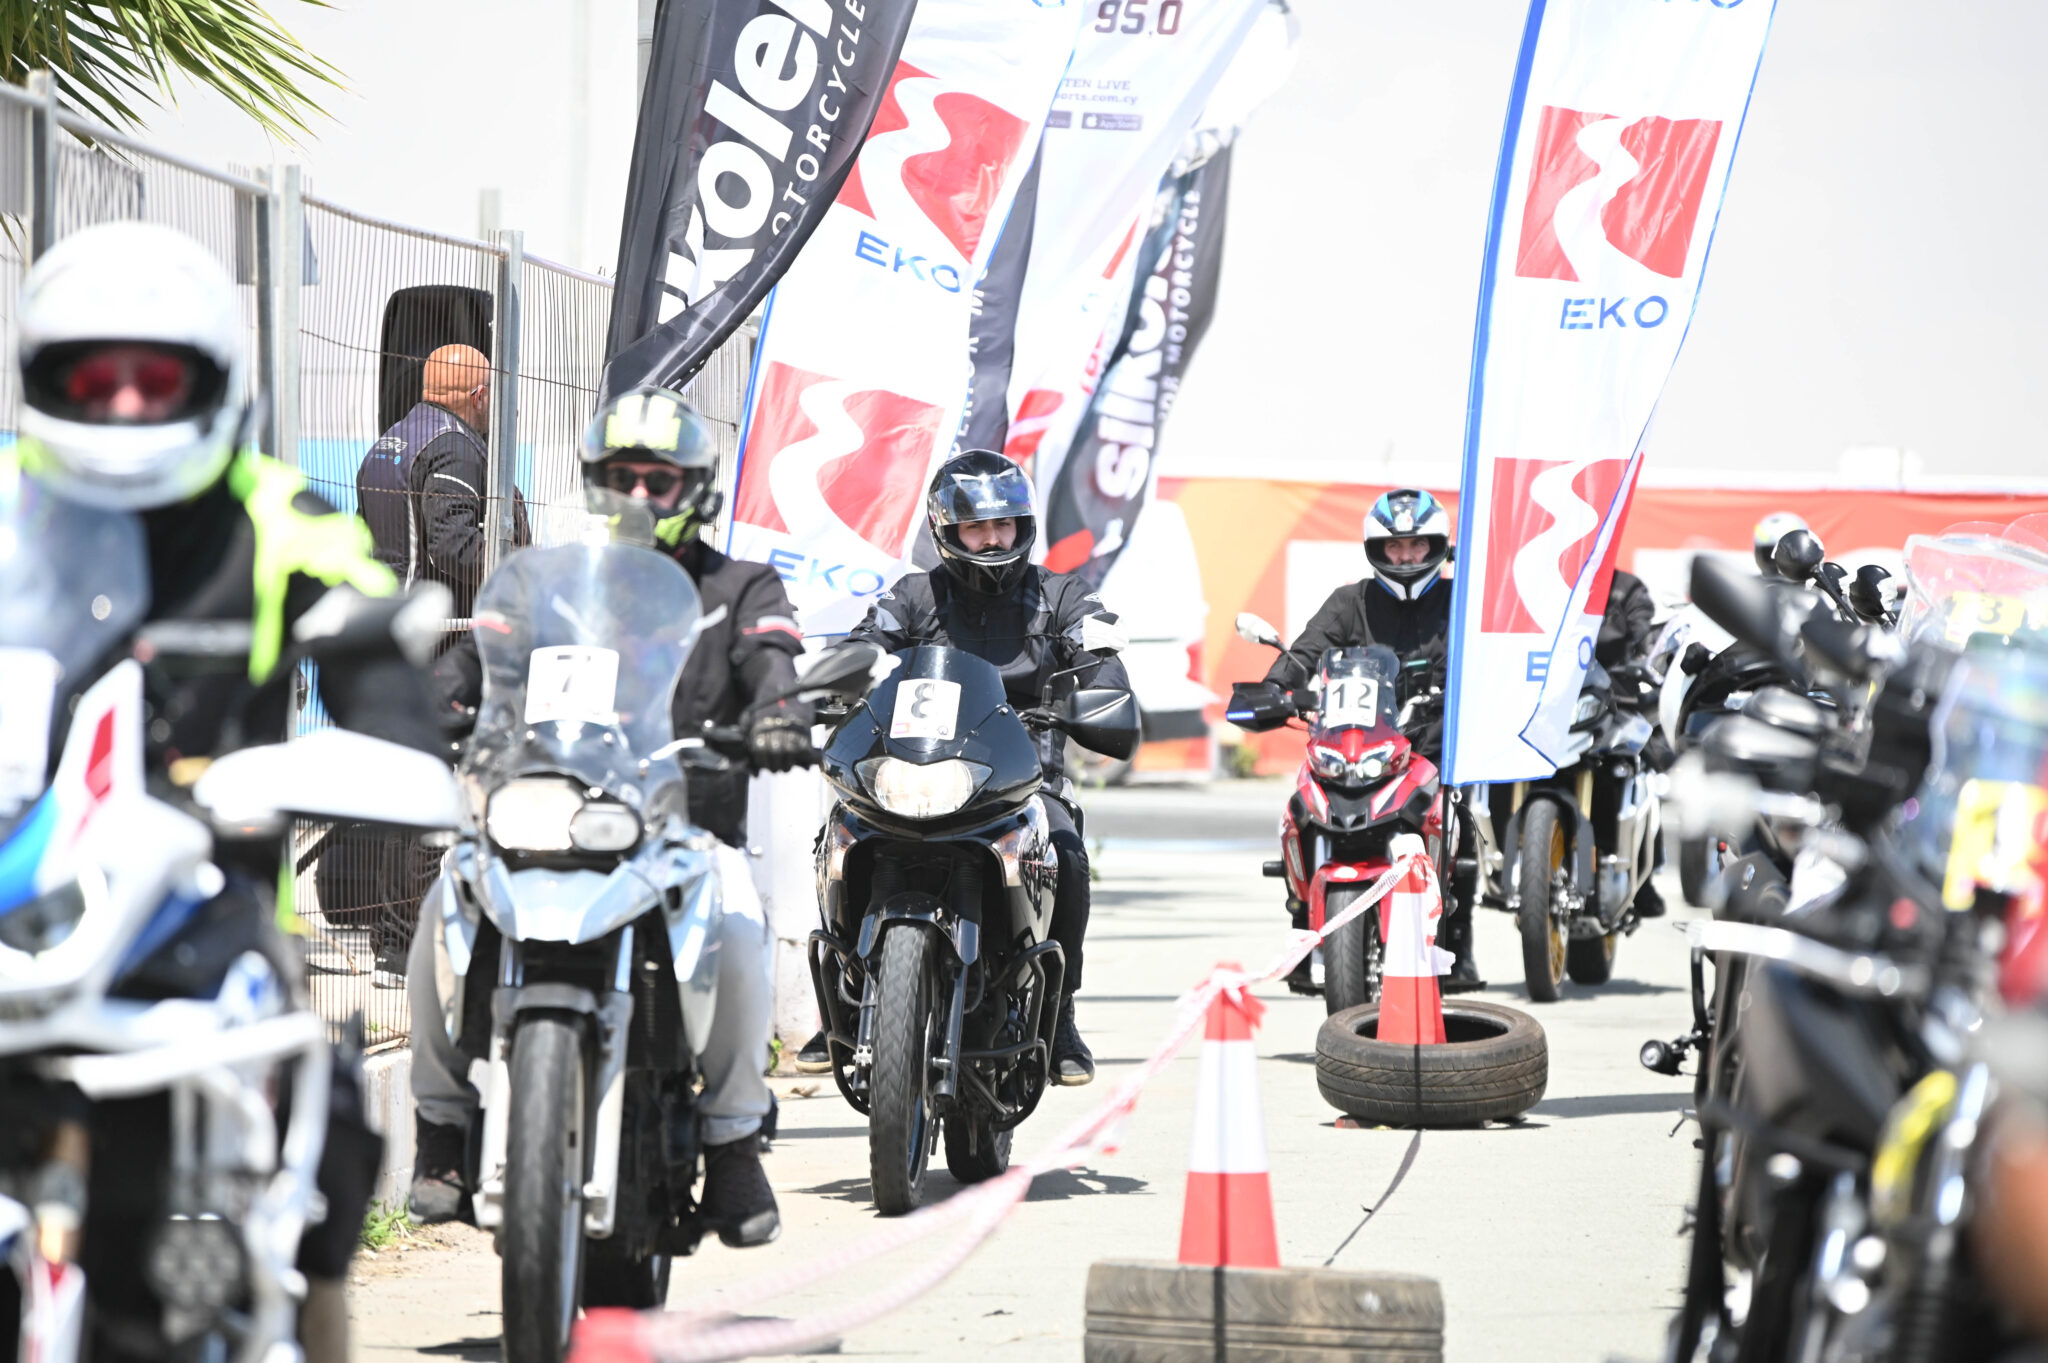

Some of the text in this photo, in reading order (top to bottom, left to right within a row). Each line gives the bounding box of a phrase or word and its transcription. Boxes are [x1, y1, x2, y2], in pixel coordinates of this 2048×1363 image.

[1094, 0, 1183, 35] 95.0
[1055, 92, 1139, 106] orts.com.cy
[1063, 77, 1131, 91] TEN LIVE
[771, 0, 868, 237] OTORCYCLE
[855, 229, 961, 294] EKO
[1560, 295, 1669, 330] EKO
[767, 548, 885, 598] EKO
[1332, 682, 1373, 710] 12
